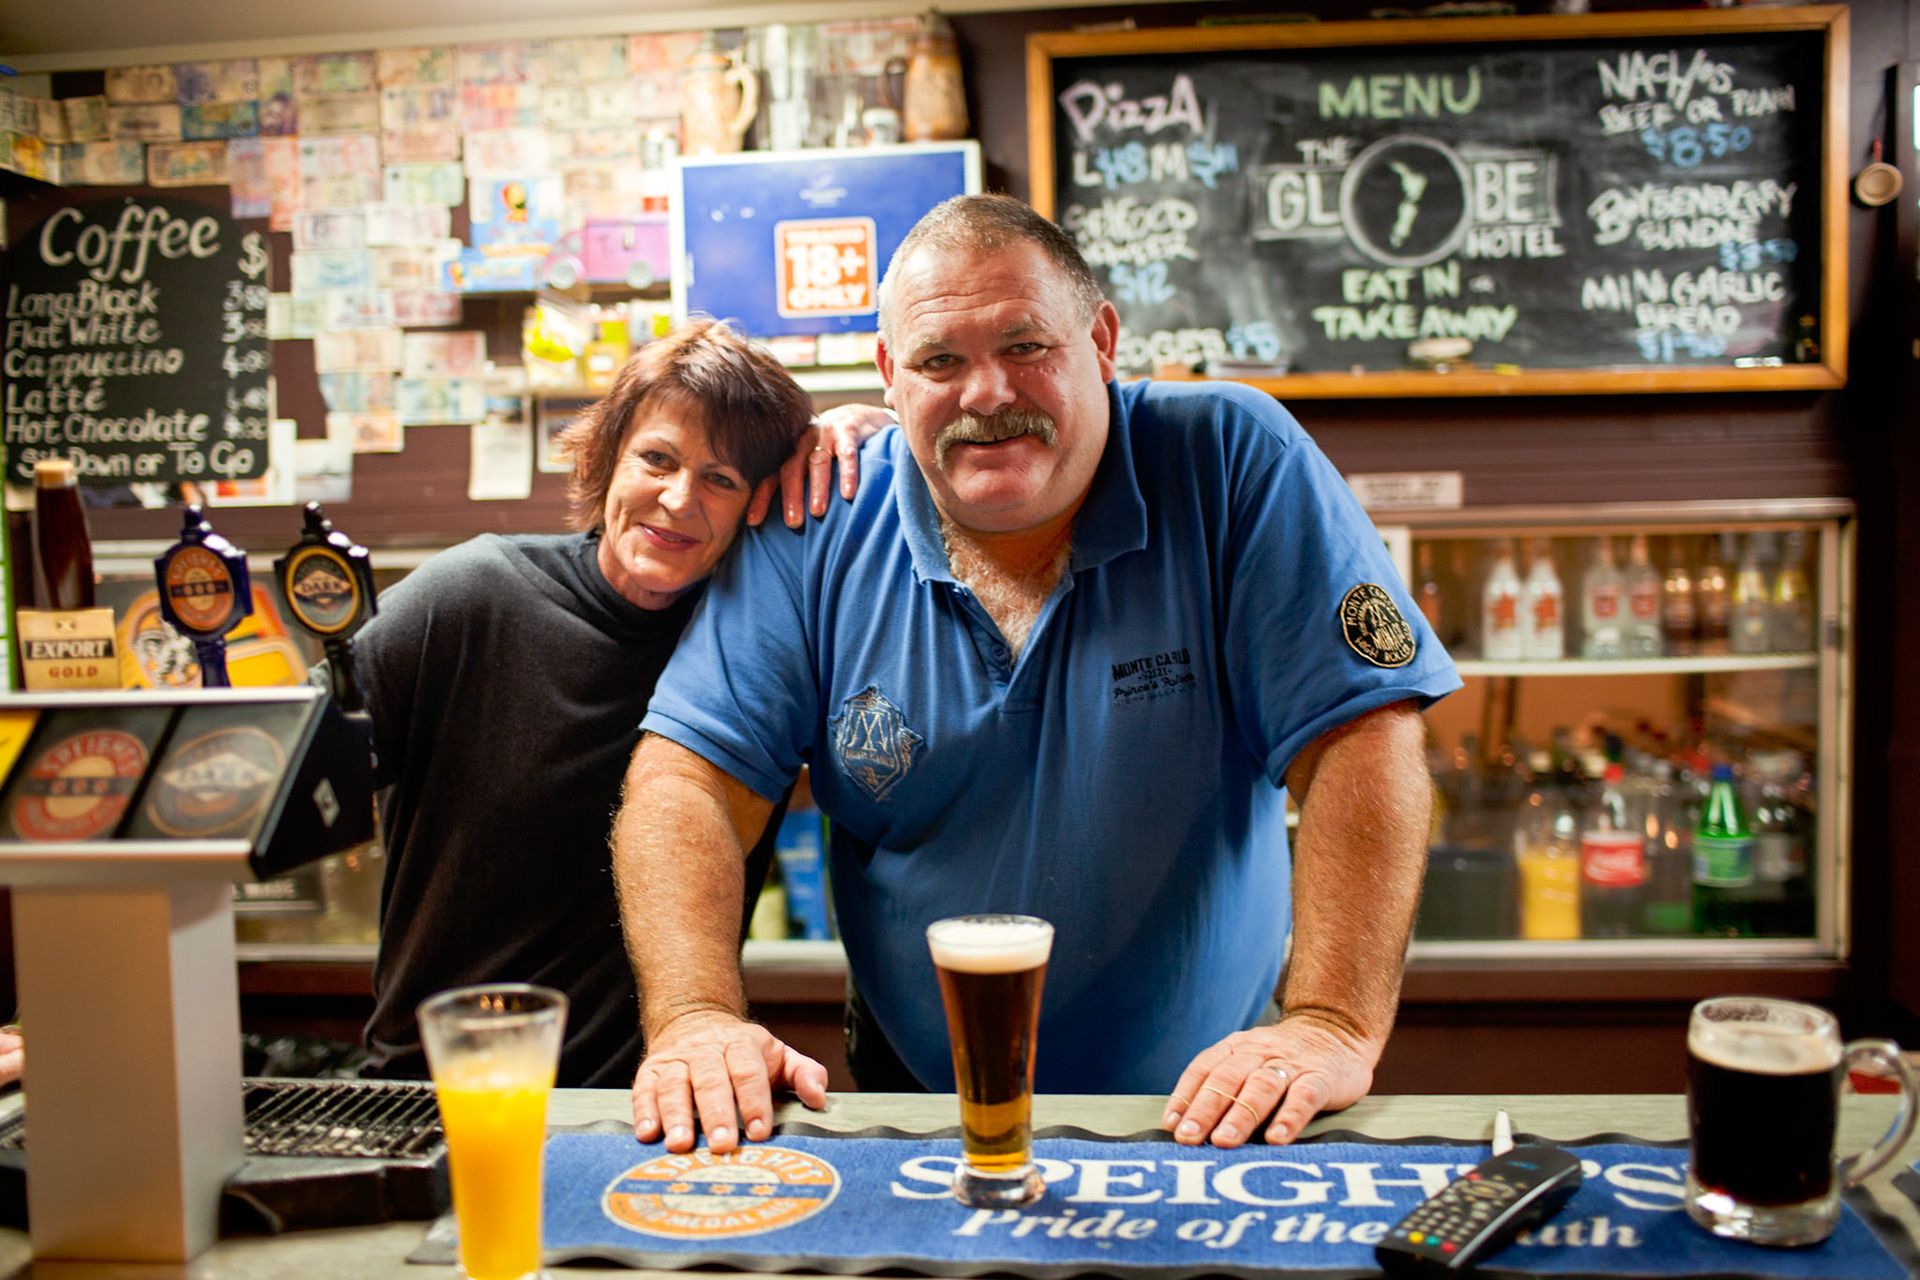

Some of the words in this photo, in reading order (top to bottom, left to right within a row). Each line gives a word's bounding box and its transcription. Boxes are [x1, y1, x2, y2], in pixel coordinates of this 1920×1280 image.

[1317, 66, 1482, 120] MENU
[1686, 95, 1723, 124] OR
[1151, 142, 1187, 183] M
[1296, 136, 1350, 164] THE
[39, 204, 221, 283] Coffee
[238, 231, 269, 280] $
[1465, 227, 1565, 258] HOTEL
[786, 245, 866, 286] 18+
[1342, 269, 1414, 303] EAT
[1422, 260, 1460, 298] IN
[76, 279, 160, 318] Black
[6, 318, 63, 350] Flat
[68, 313, 163, 347] White
[1312, 304, 1418, 341] TAKE
[1419, 304, 1518, 342] AWAY
[4, 347, 185, 388] Cappuccino
[5, 414, 62, 444] Hot
[63, 407, 211, 443] Chocolate
[134, 450, 166, 477] or
[167, 441, 206, 476] To
[208, 440, 255, 480] Go
[30, 639, 109, 659] EXPORT
[1112, 657, 1153, 682] MONTE
[1155, 645, 1191, 667] CARLO
[48, 665, 98, 679] GOLD
[951, 1208, 1158, 1239] Pride
[1176, 1210, 1266, 1249] of
[1272, 1213, 1390, 1243] the
